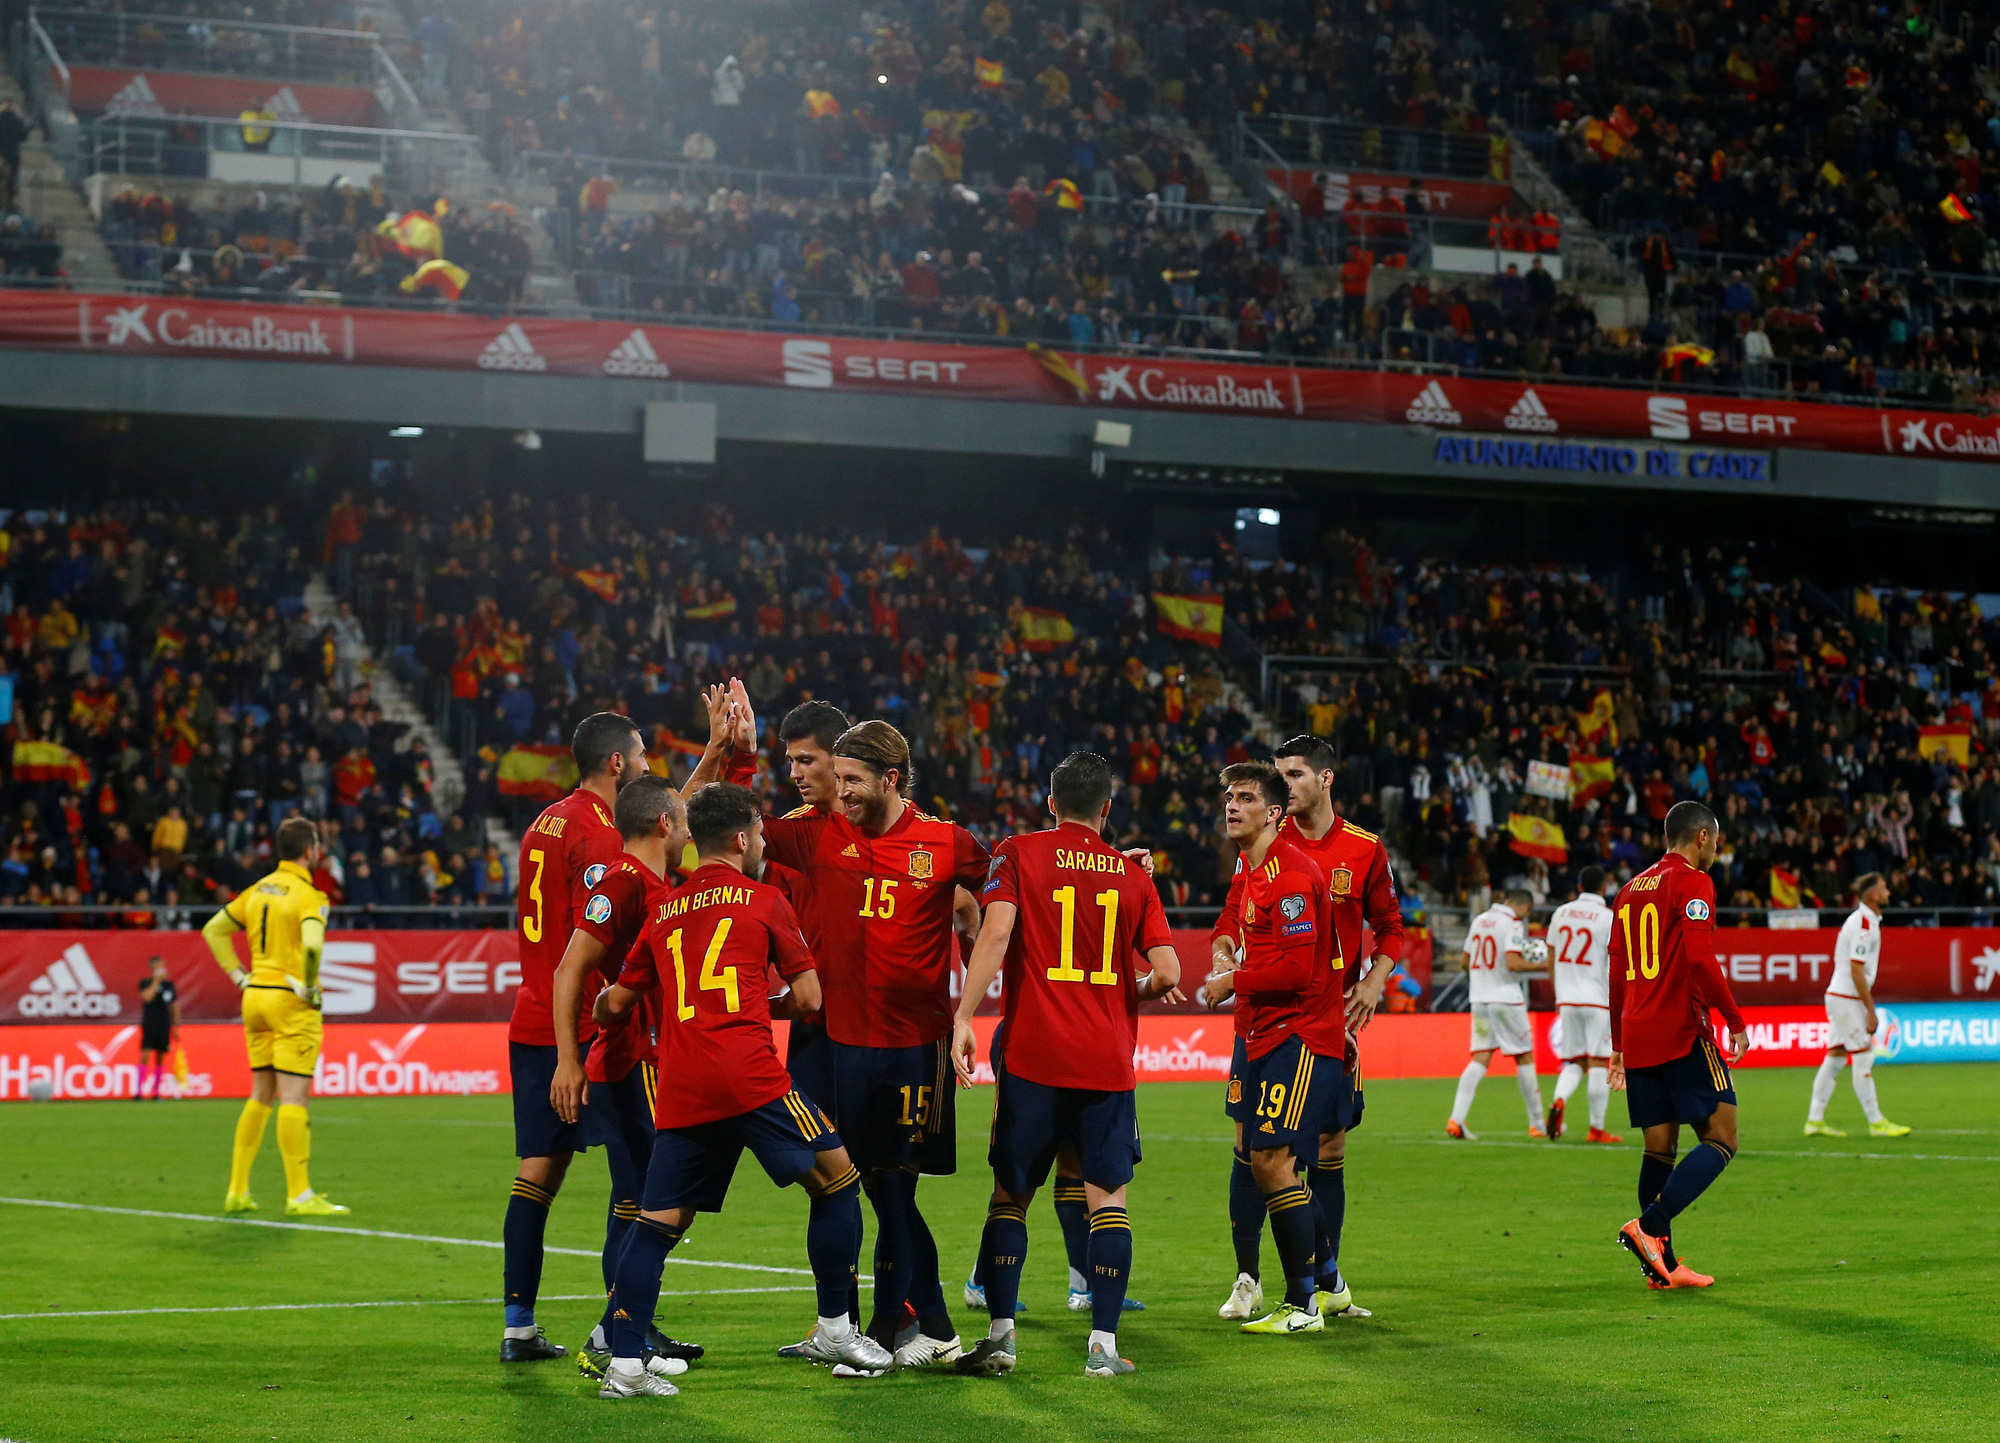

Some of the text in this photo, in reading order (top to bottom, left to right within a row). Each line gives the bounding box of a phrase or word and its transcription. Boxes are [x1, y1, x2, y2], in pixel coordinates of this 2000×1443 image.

[156, 308, 330, 355] CaixaBank
[477, 353, 547, 372] adidas
[602, 358, 671, 379] adidas
[844, 356, 967, 383] SEAT
[1138, 367, 1285, 410] CaixaBank
[1405, 408, 1463, 426] adidas
[1503, 414, 1559, 432] adidas
[1698, 411, 1798, 437] SEAT
[1435, 436, 1637, 476] AYUNTAMIENTO
[1646, 449, 1681, 478] DE
[1055, 848, 1126, 876] SARABIA
[523, 848, 545, 943] 3
[858, 877, 899, 919] 15
[1629, 874, 1662, 892] THIAGO
[655, 885, 755, 924] JUAN BERNAT
[260, 903, 269, 954] 1
[1047, 885, 1119, 986] 11
[1289, 923, 1313, 933] RESPECT
[1558, 925, 1593, 966] 22
[1618, 902, 1660, 981] 10
[666, 917, 741, 1023] 14
[1471, 933, 1498, 970] 20
[18, 992, 121, 1017] adidas
[1904, 1018, 2000, 1048] UEFA EU
[897, 1085, 932, 1126] 15
[1256, 1080, 1287, 1118] 19
[1095, 1265, 1120, 1278] RFEF
